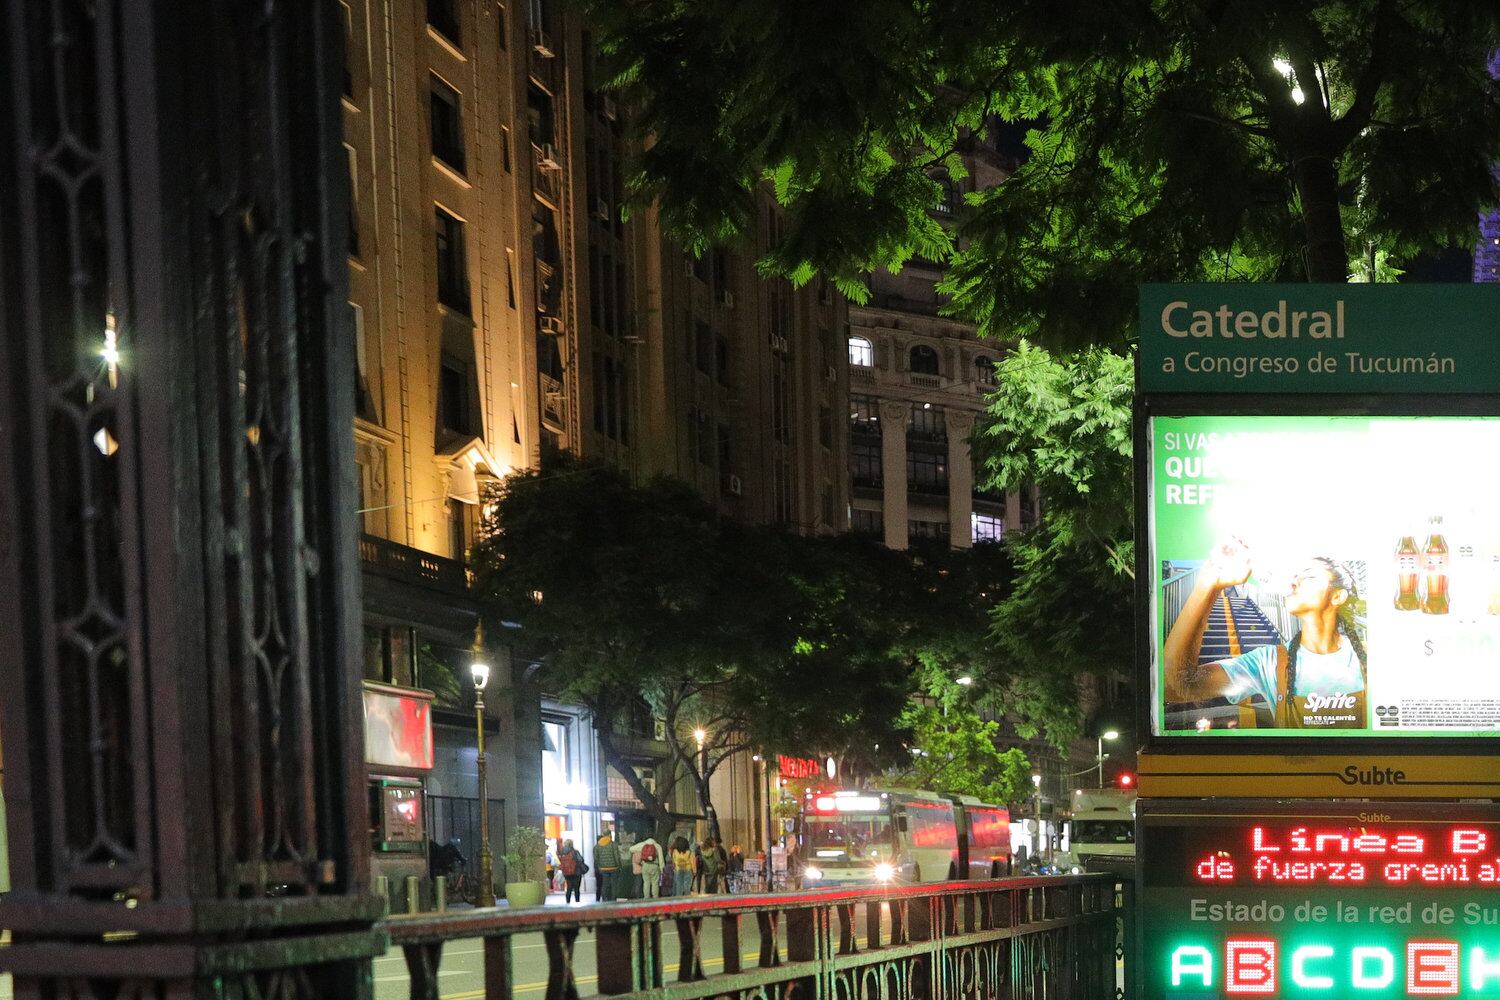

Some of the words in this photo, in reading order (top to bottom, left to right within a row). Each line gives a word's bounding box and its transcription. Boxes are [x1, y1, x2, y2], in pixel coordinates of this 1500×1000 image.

[1161, 300, 1345, 339] Catedral
[1162, 357, 1175, 373] a
[1184, 352, 1299, 378] Congreso
[1307, 352, 1337, 373] de
[1345, 352, 1455, 374] Tucumán
[1164, 432, 1180, 450] SI
[1304, 692, 1356, 712] Sprite
[1344, 766, 1406, 786] Subte
[1359, 811, 1391, 823] Subte
[1453, 830, 1487, 853] B
[1197, 855, 1233, 880] de
[1254, 860, 1365, 881] fuerza
[1190, 899, 1285, 923] Estado
[1294, 899, 1330, 923] de
[1336, 900, 1360, 924] la
[1368, 901, 1413, 924] red
[1421, 902, 1456, 925] de
[1171, 945, 1213, 987] A
[1233, 948, 1271, 987] B
[1292, 945, 1334, 988] C
[1352, 946, 1395, 989] D
[1414, 950, 1452, 987] E
